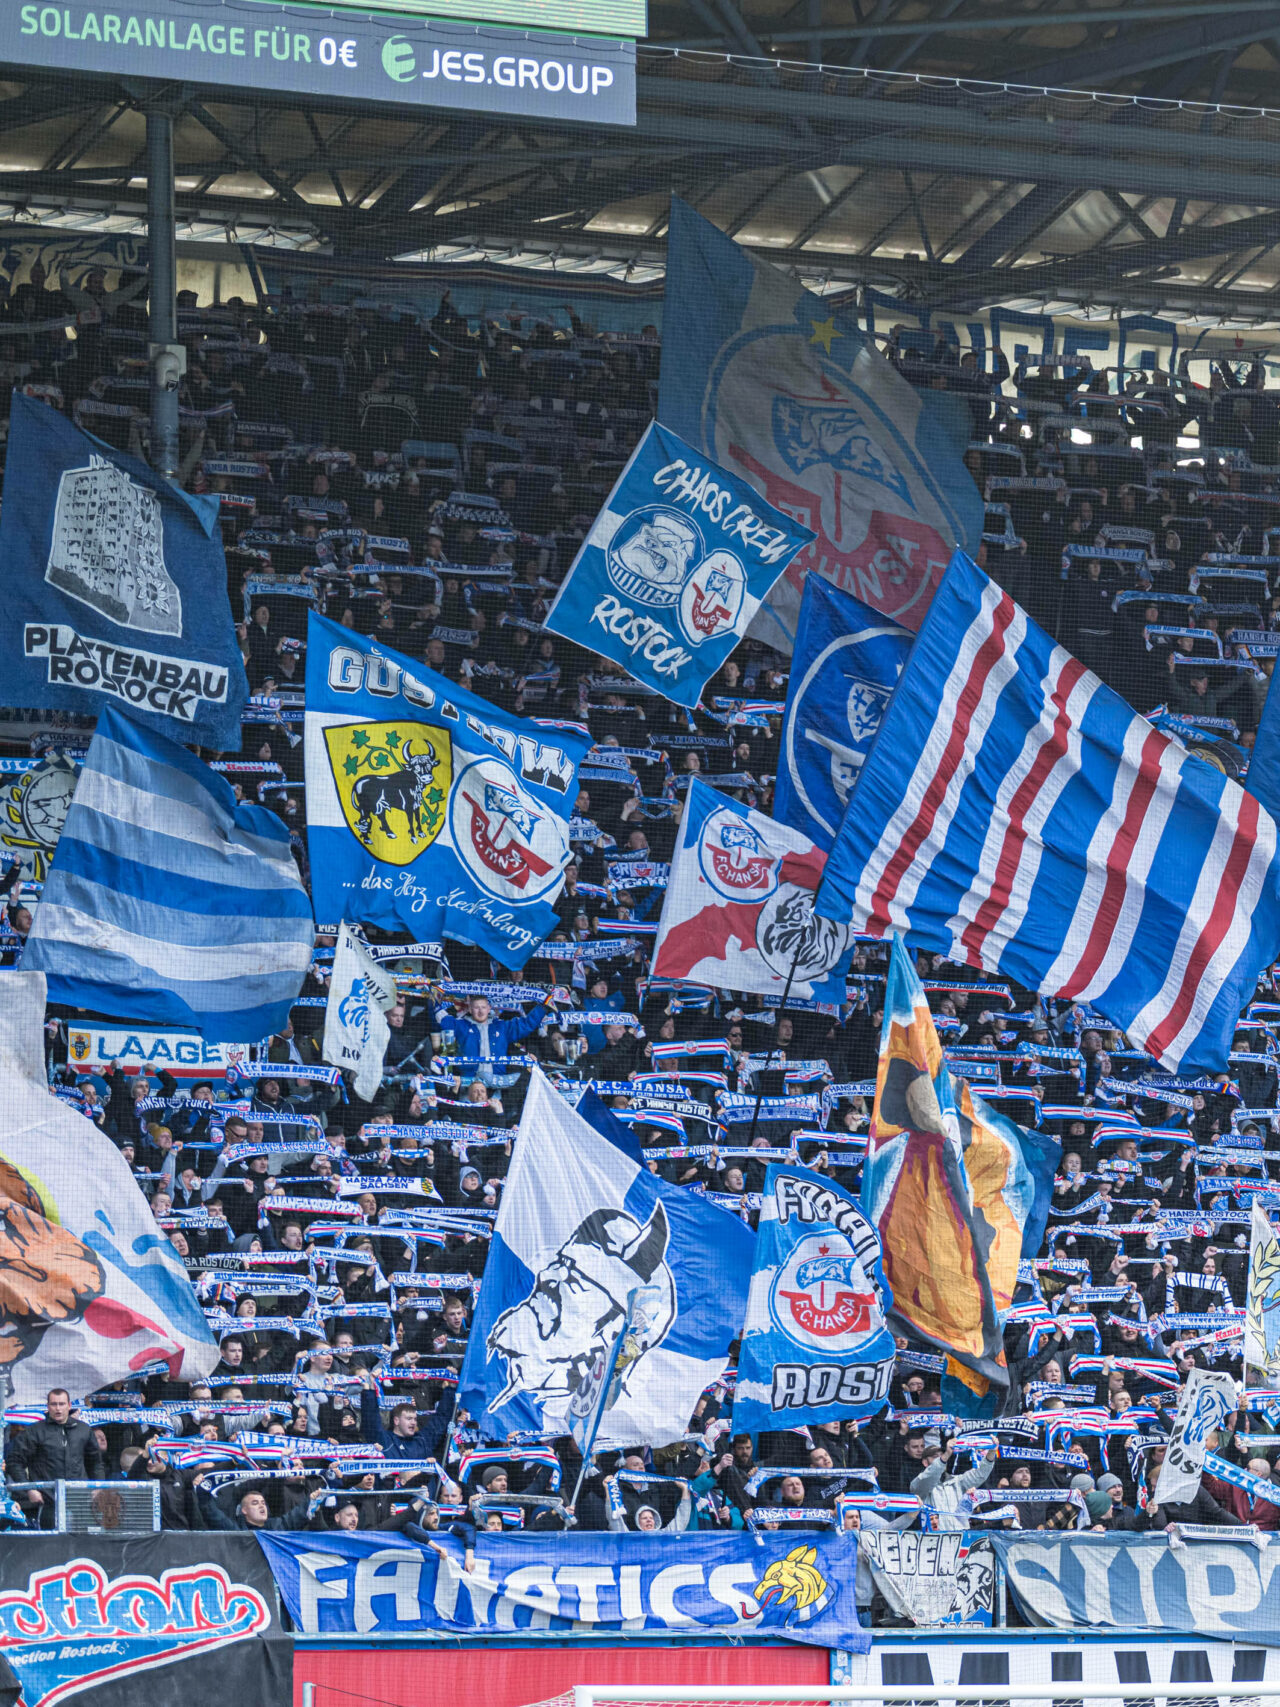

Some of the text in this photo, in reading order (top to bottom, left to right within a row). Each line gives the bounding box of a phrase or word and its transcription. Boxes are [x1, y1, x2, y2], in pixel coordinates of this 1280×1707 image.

[20, 5, 358, 68] SOLARANLAGE FÜR 0€
[422, 48, 614, 96] JES.GROUP
[653, 459, 798, 566] CHAOS CREW
[589, 594, 692, 680] ROSTOCK
[1237, 632, 1265, 642] HANSA
[361, 866, 430, 912] das Herz
[97, 1036, 224, 1065] LAAGE
[597, 1081, 684, 1093] F.C. HANSA
[360, 1182, 409, 1190] SACHSEN
[1169, 1210, 1250, 1220] HANSA ROSTOCK
[1216, 1327, 1242, 1341] Hansa
[997, 1419, 1038, 1434] ROSTOCK
[860, 1530, 964, 1577] GEGEN
[298, 1549, 757, 1632] FANATICS
[59, 1641, 118, 1660] Rostock
